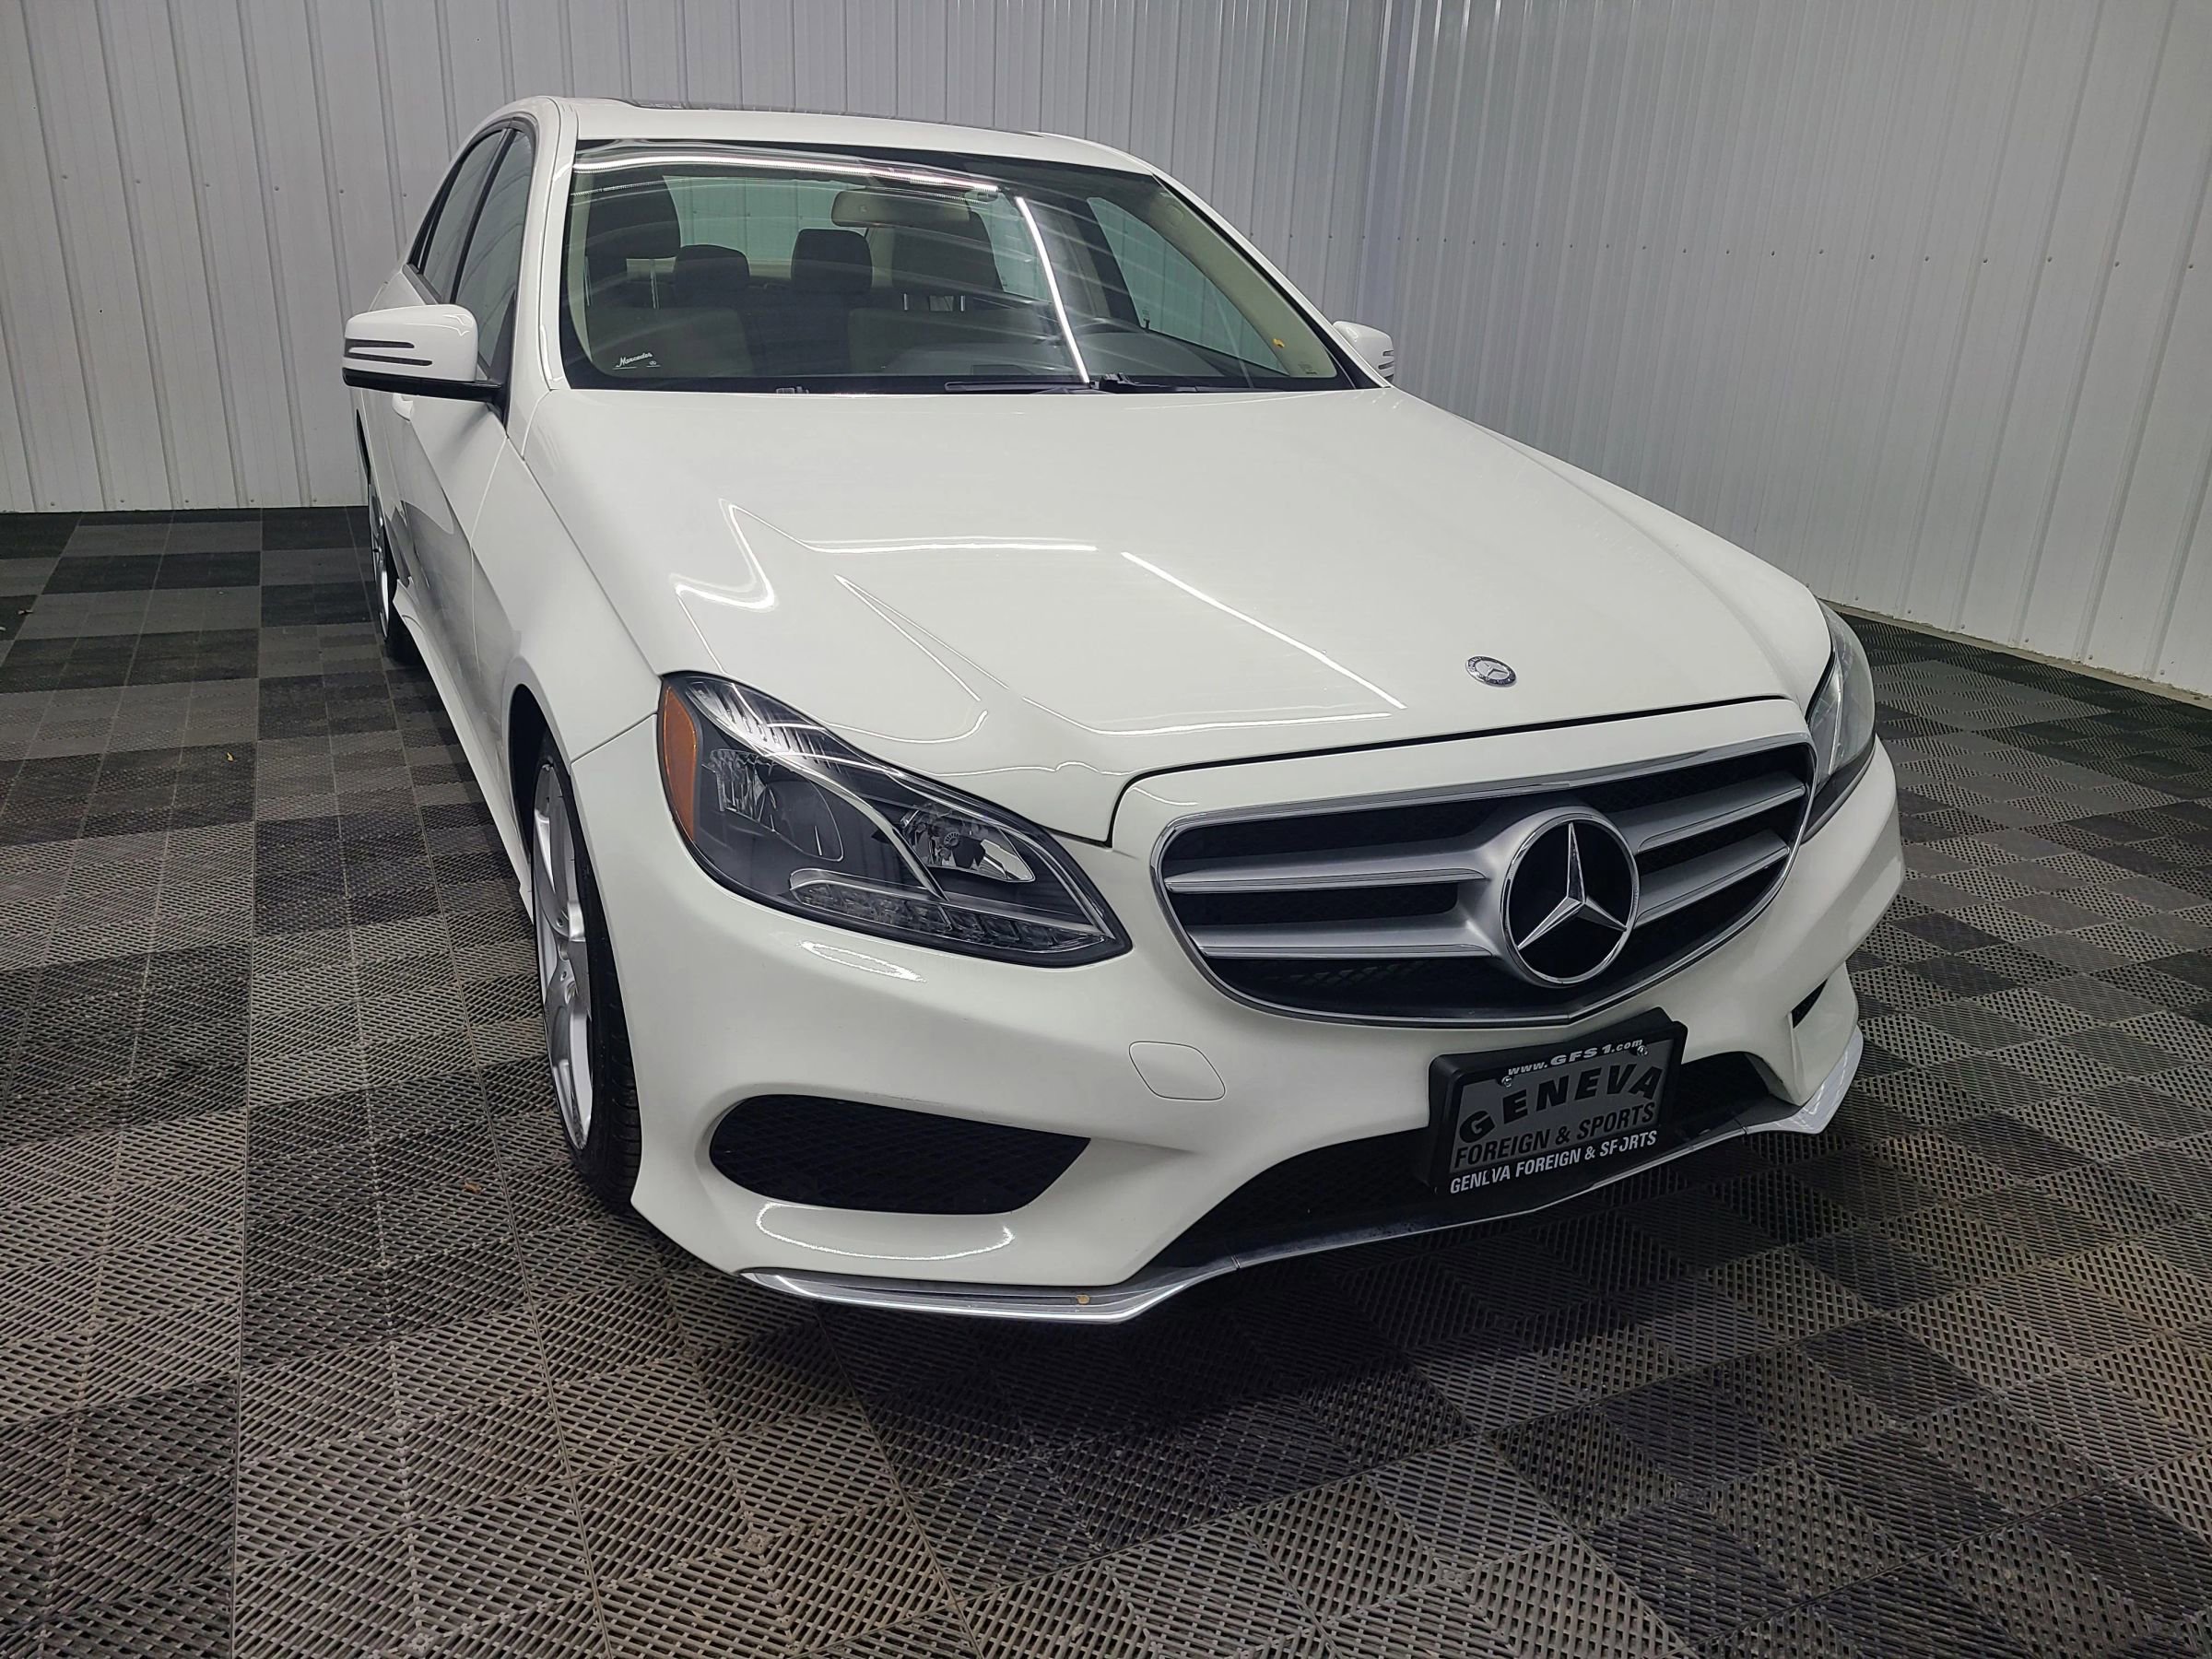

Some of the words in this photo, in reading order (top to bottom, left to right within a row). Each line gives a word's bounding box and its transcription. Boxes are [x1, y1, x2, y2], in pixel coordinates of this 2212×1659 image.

[1454, 1129, 1550, 1169] FOREIGN
[1555, 1124, 1571, 1145] &
[1576, 1101, 1655, 1140] SPORTS
[1459, 1063, 1664, 1144] GENEVA
[1515, 1148, 1582, 1178] FOREIGN
[1584, 1146, 1596, 1160] &
